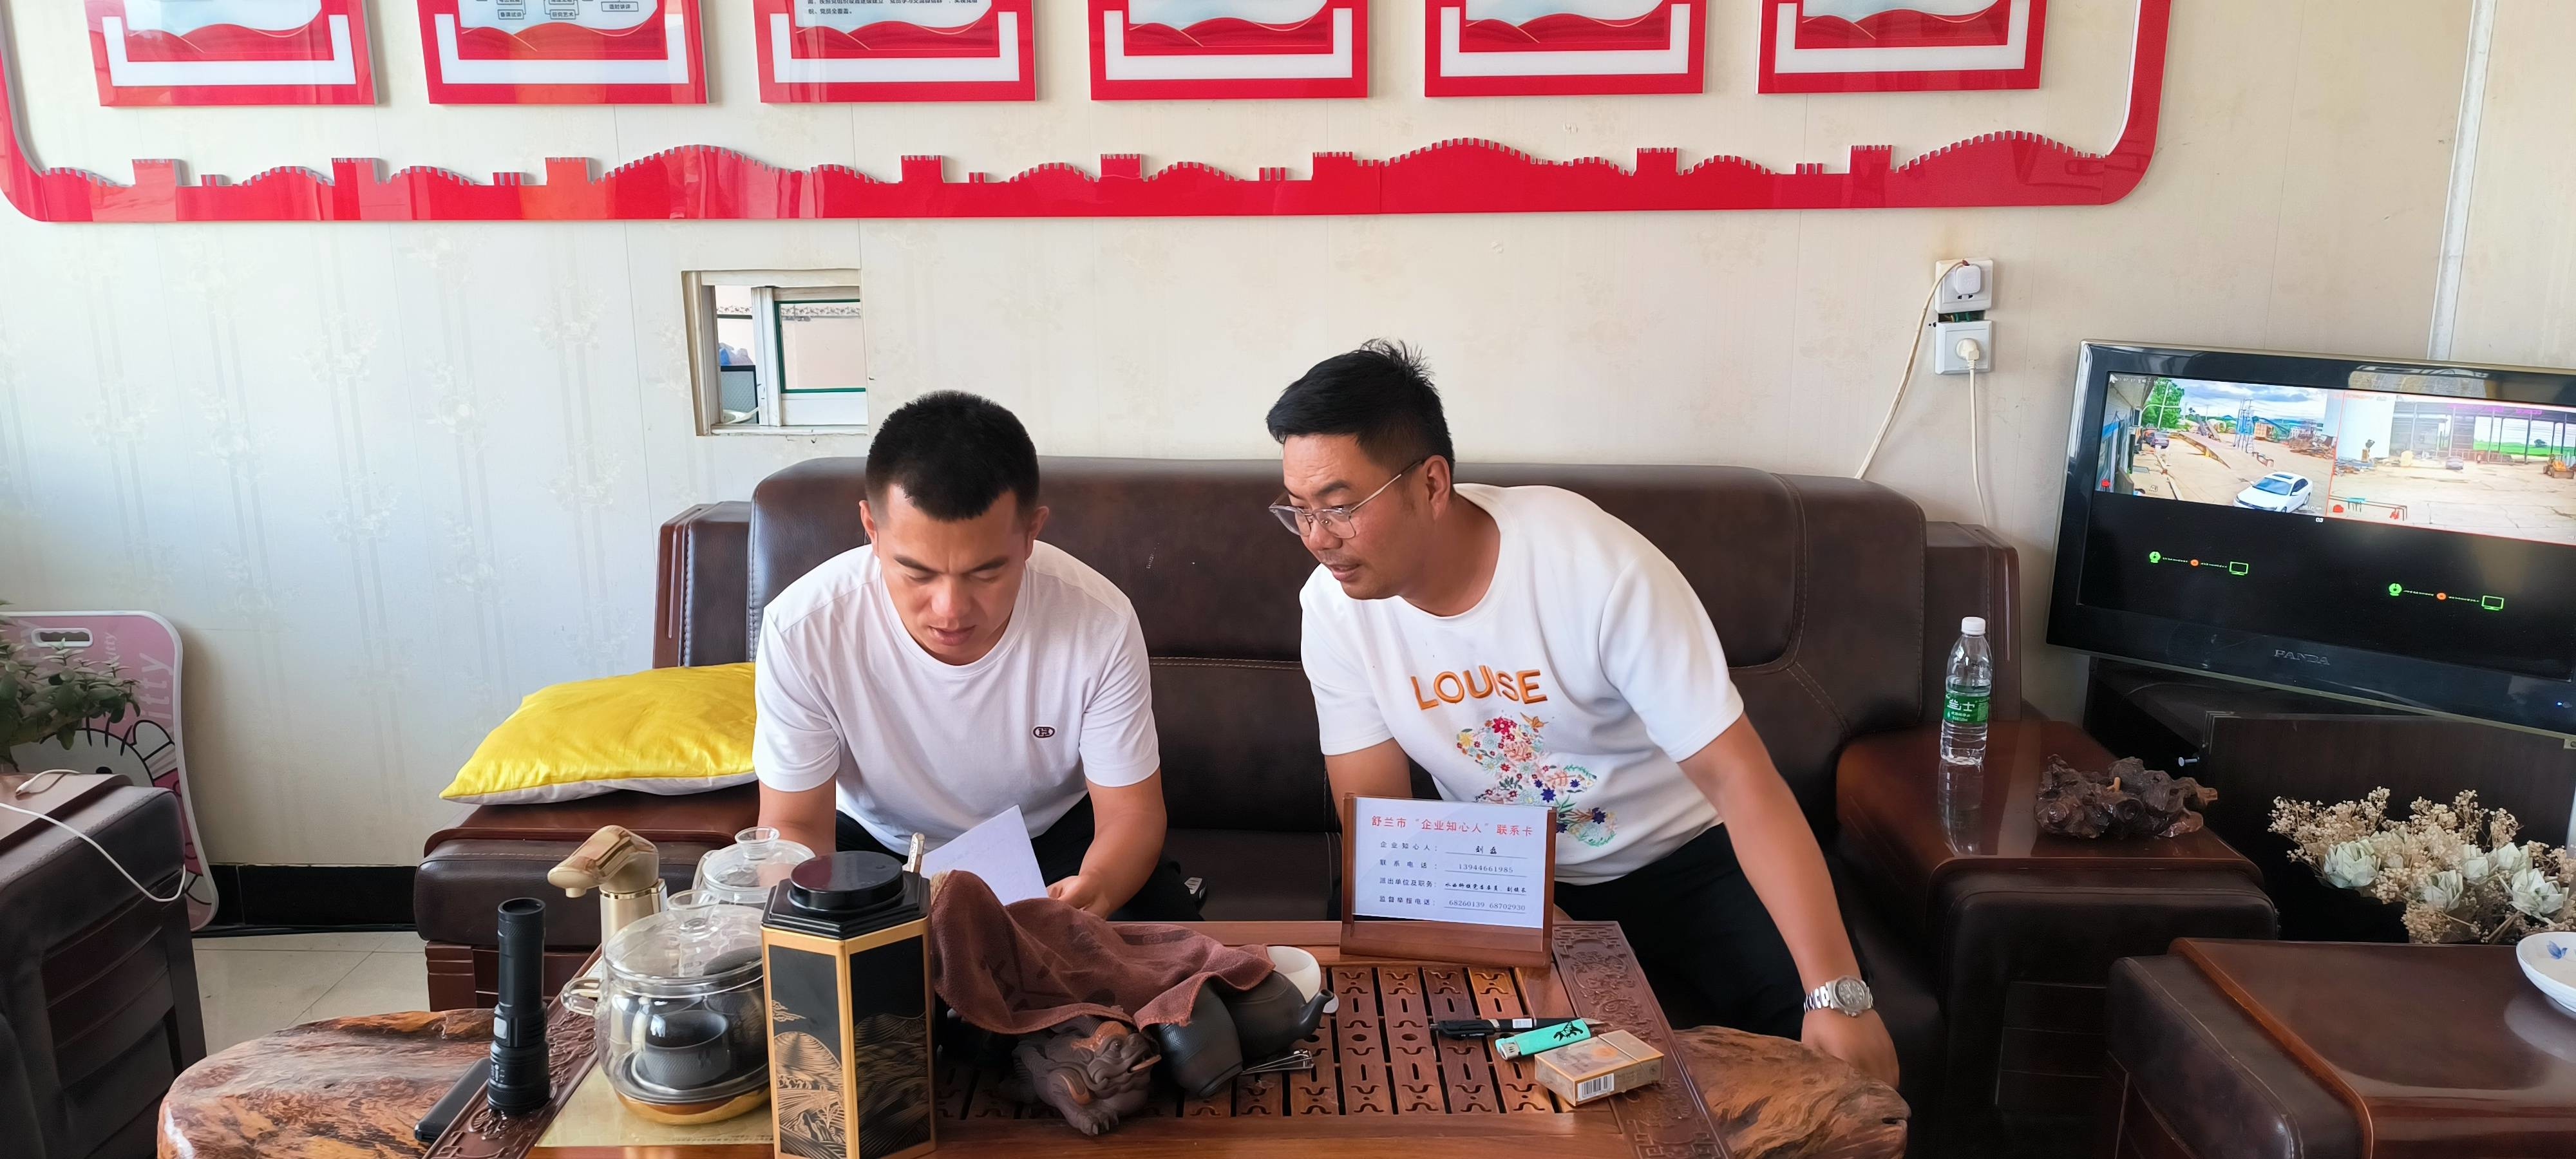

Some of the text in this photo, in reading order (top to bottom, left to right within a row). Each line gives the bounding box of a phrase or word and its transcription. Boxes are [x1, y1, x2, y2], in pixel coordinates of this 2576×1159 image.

[1459, 863, 1513, 873] 13944661985
[1449, 900, 1485, 908] 68260139
[1489, 903, 1526, 911] 68702930
